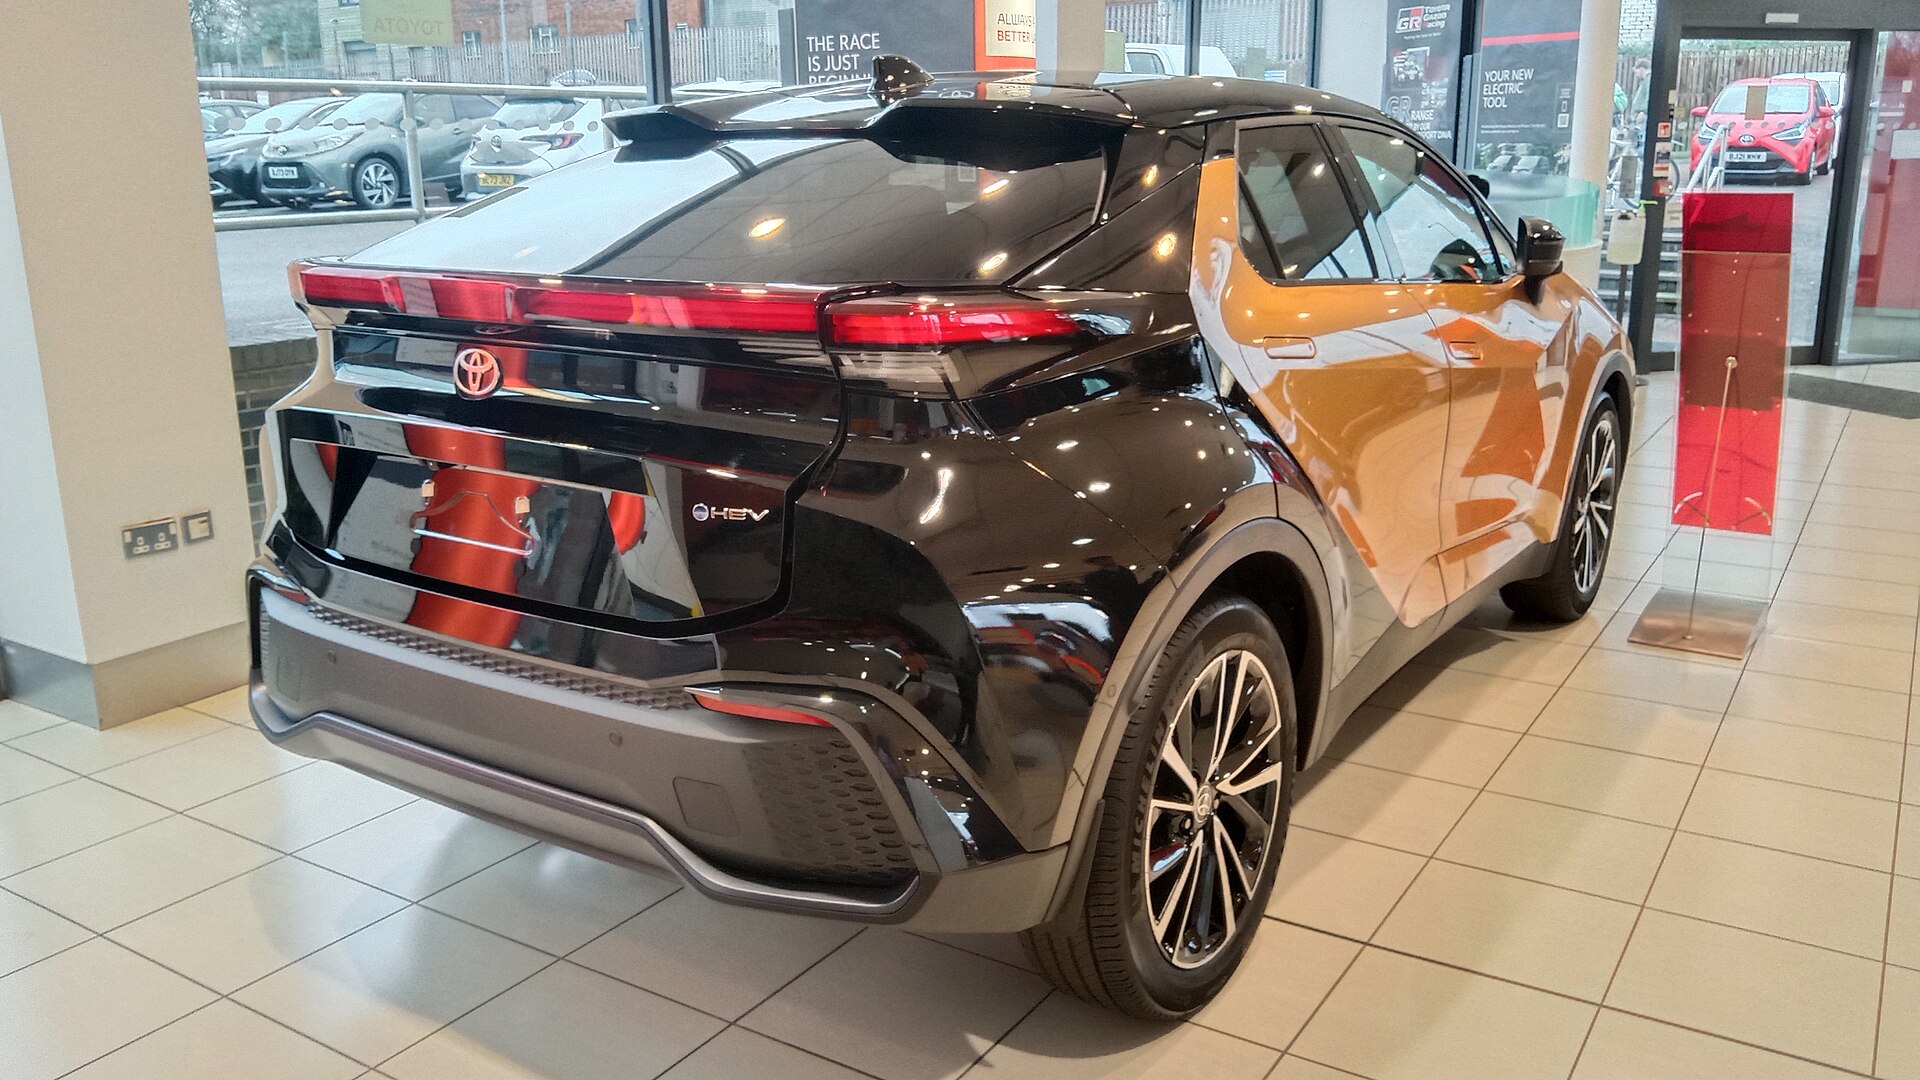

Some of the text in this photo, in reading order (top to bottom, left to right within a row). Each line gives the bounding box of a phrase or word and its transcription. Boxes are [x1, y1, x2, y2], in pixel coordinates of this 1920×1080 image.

[997, 13, 1032, 27] ALWAYS
[1398, 16, 1421, 30] GR
[806, 32, 880, 52] THE RACE
[997, 30, 1030, 43] BETTER
[808, 54, 860, 72] IS JUST
[1484, 68, 1534, 82] YOUR NEW
[1482, 83, 1524, 95] ELECTRIC
[1482, 97, 1507, 108] TOOL
[1411, 110, 1434, 121] RANGE
[710, 506, 770, 521] HEV
[1131, 716, 1166, 876] MICHELIN
